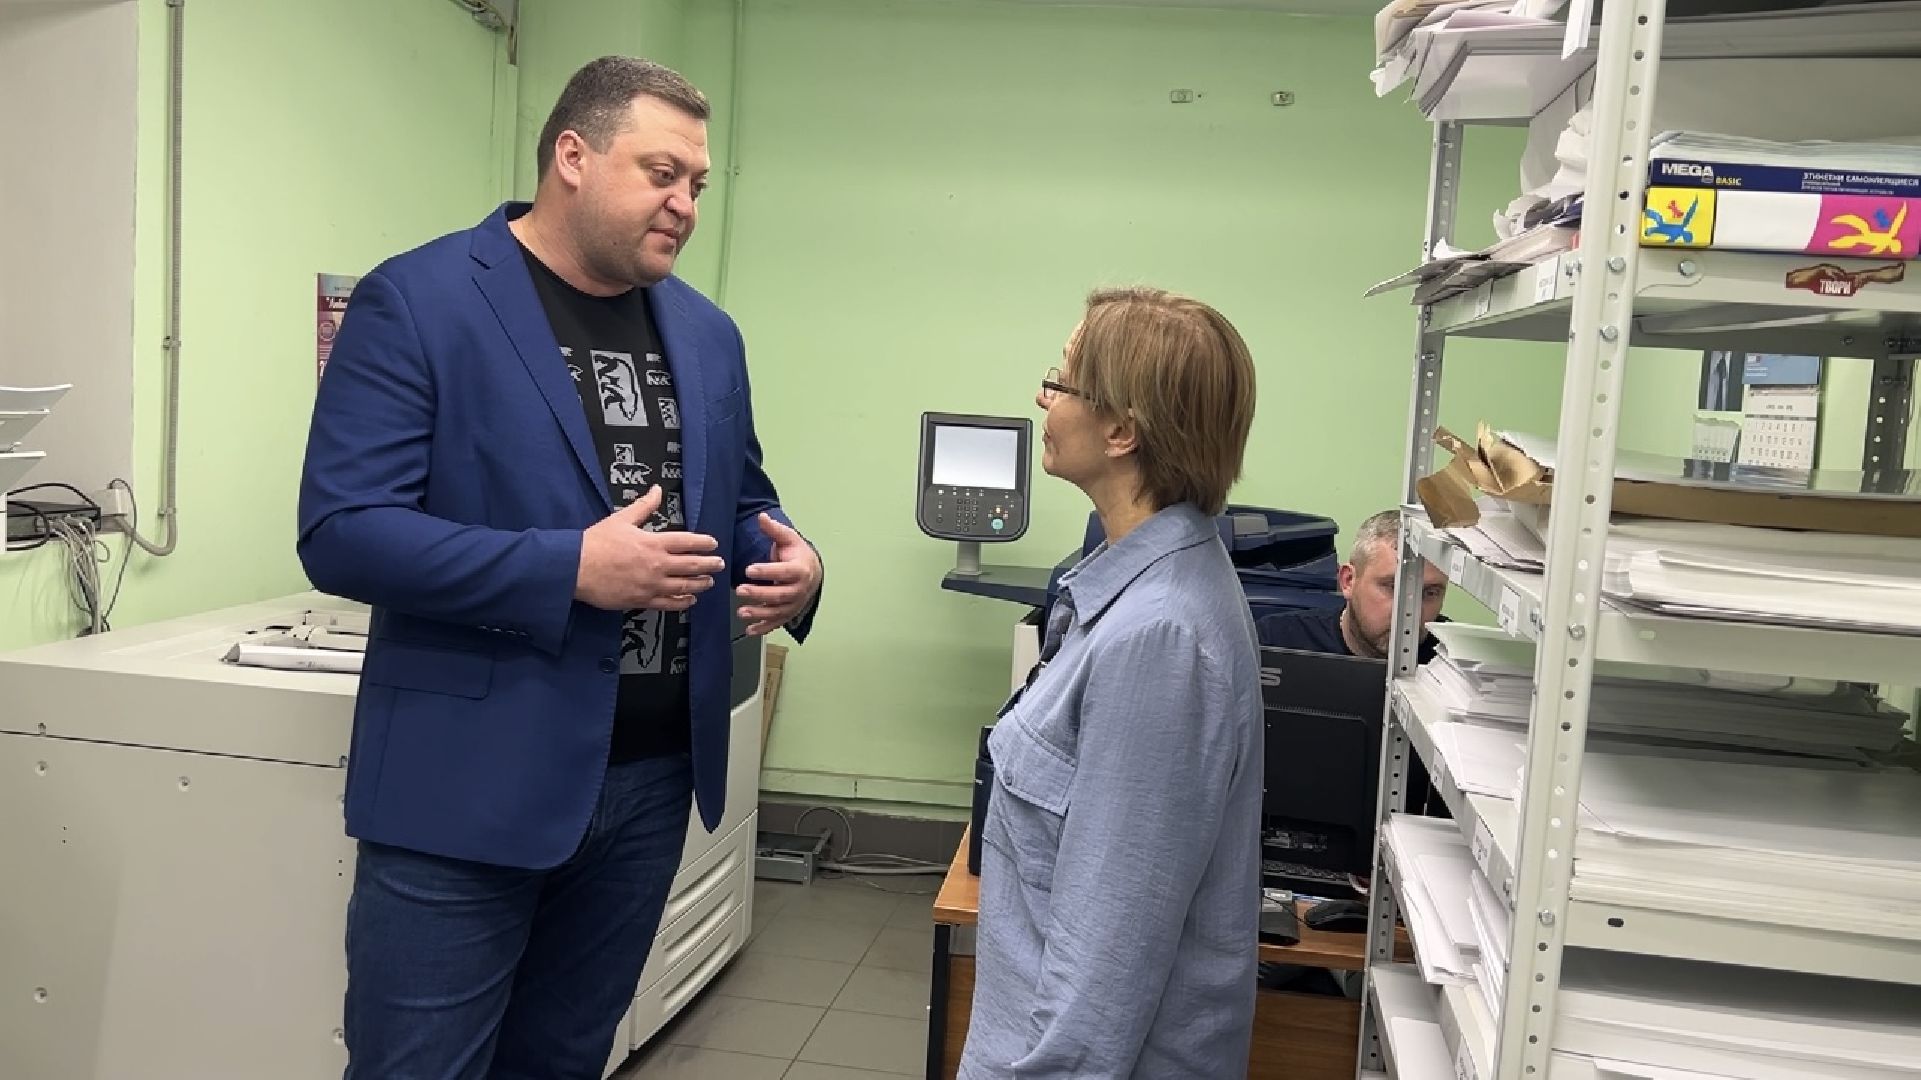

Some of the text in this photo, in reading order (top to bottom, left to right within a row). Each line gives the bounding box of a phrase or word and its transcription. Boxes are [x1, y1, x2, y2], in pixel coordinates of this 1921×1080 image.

[1661, 162, 1714, 177] MEGA
[1715, 175, 1742, 186] BASIC
[1819, 279, 1851, 294] ТВОРИ
